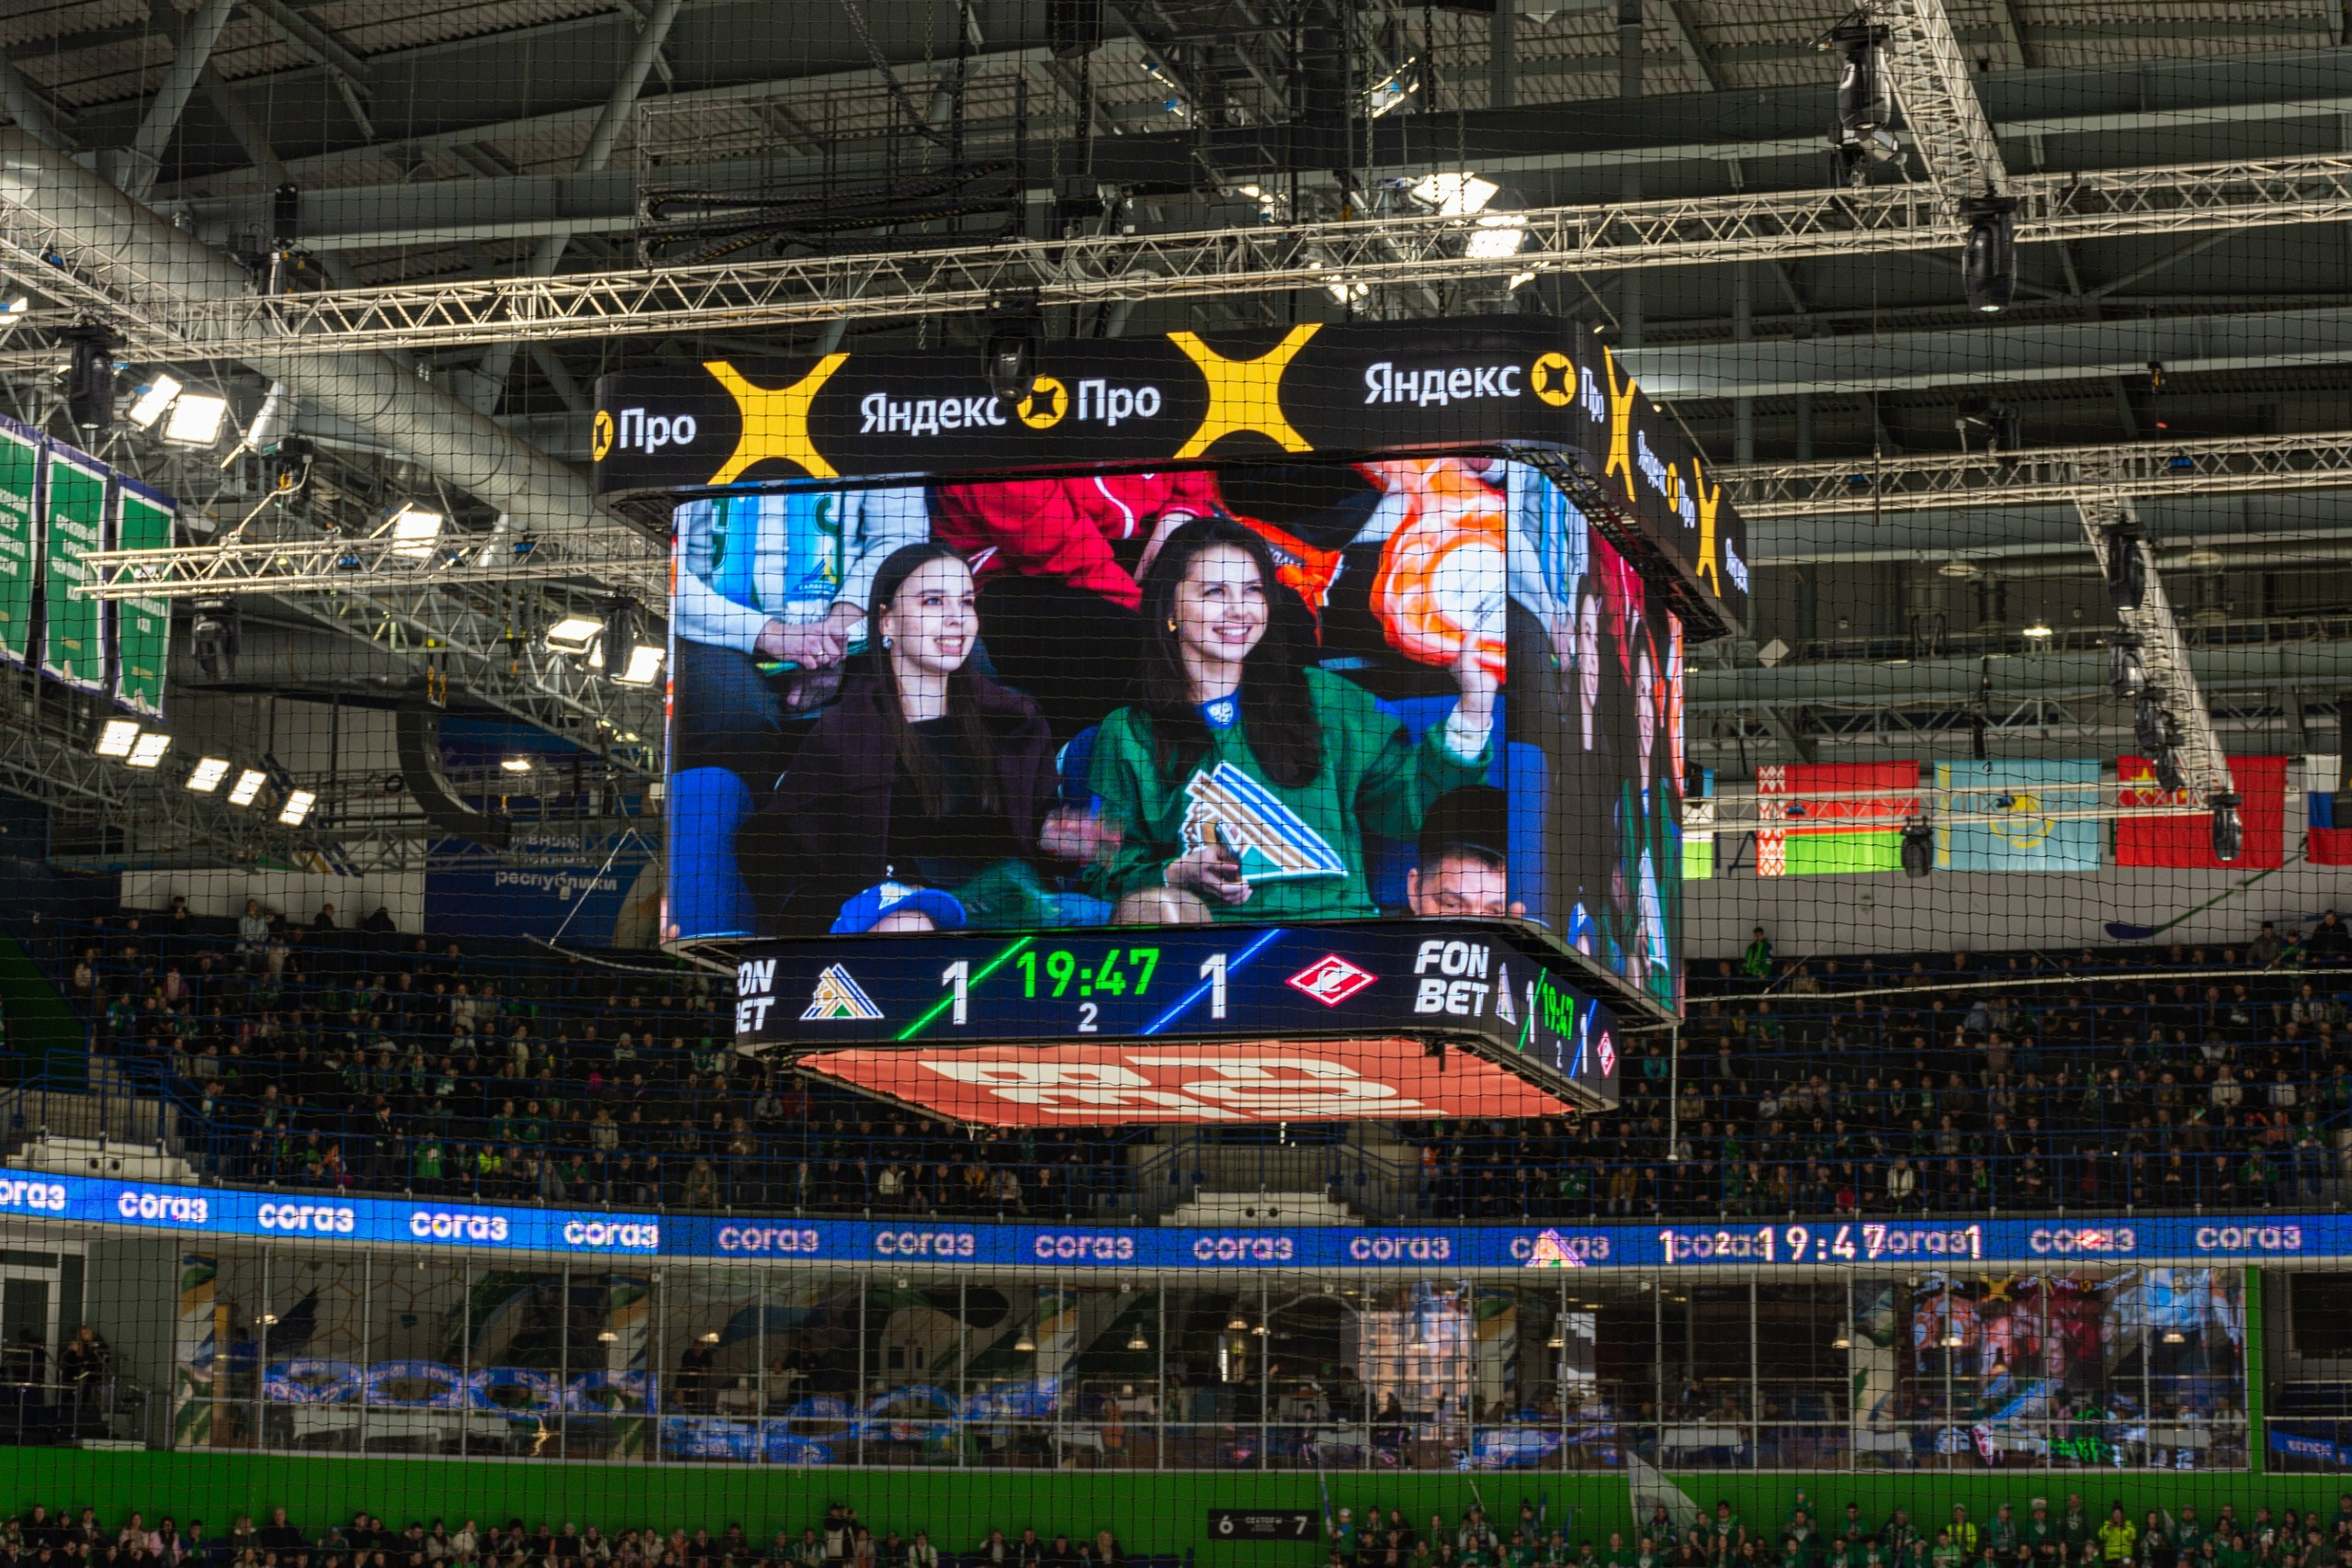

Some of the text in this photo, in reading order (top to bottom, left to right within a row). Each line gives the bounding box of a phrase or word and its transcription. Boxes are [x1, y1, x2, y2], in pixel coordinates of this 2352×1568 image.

[859, 378, 1161, 437] Яндекс Про
[1364, 362, 1605, 423] Яндекс Про
[620, 407, 696, 454] Про
[1678, 477, 1696, 529] Про
[495, 871, 617, 891] республики
[737, 959, 777, 997] ON
[1414, 940, 1489, 979] FON
[943, 948, 1227, 1025] 1 19:47 1
[1414, 979, 1490, 1017] BET
[1078, 1002, 1098, 1032] 2
[1542, 982, 1574, 1041] 19:47
[118, 1190, 209, 1224] согаз
[257, 1202, 355, 1233] согаз
[410, 1211, 508, 1241] согаз
[563, 1219, 660, 1248] согаз
[718, 1224, 820, 1252] согаз
[876, 1230, 975, 1257] согаз
[1035, 1235, 1135, 1259] согаз
[1193, 1235, 1293, 1260] согаз
[1350, 1235, 1450, 1260] согаз
[1510, 1235, 1611, 1259] саз
[2196, 1224, 2302, 1250] согаз
[1218, 1515, 1234, 1534] 6
[1294, 1516, 1308, 1535] 7
